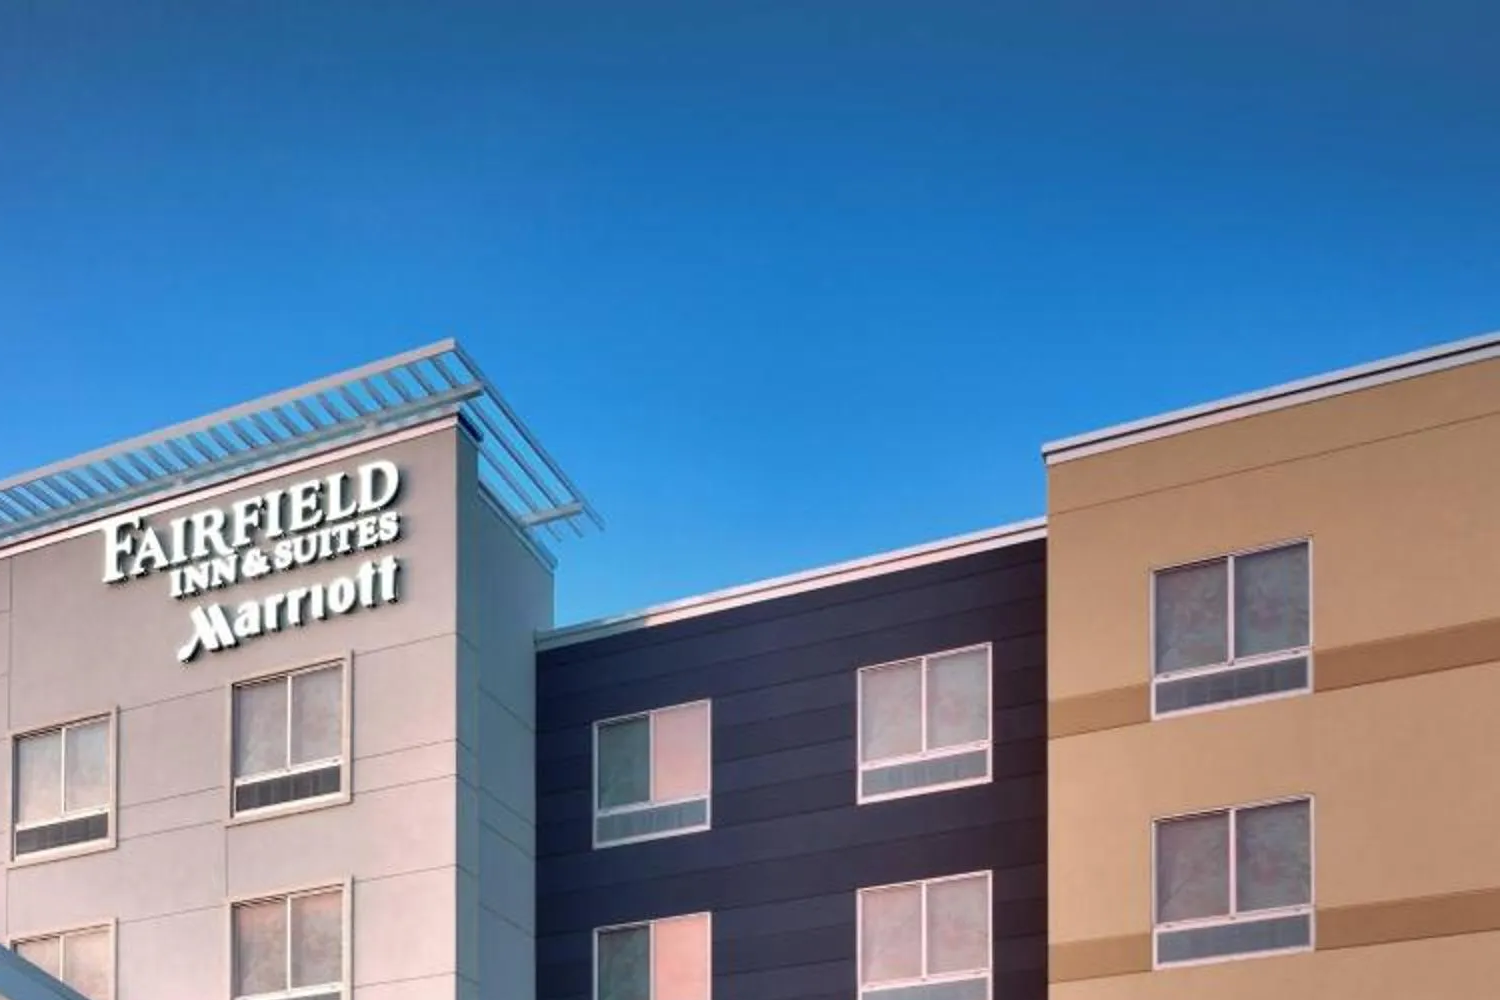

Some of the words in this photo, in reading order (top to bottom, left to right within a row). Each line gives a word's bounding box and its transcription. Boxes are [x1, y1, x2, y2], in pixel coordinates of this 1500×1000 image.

[101, 459, 400, 584] FAIRFIELD
[169, 554, 238, 598] INN
[241, 548, 271, 578] &
[273, 511, 400, 570] SUITES
[177, 554, 399, 662] Marriott
